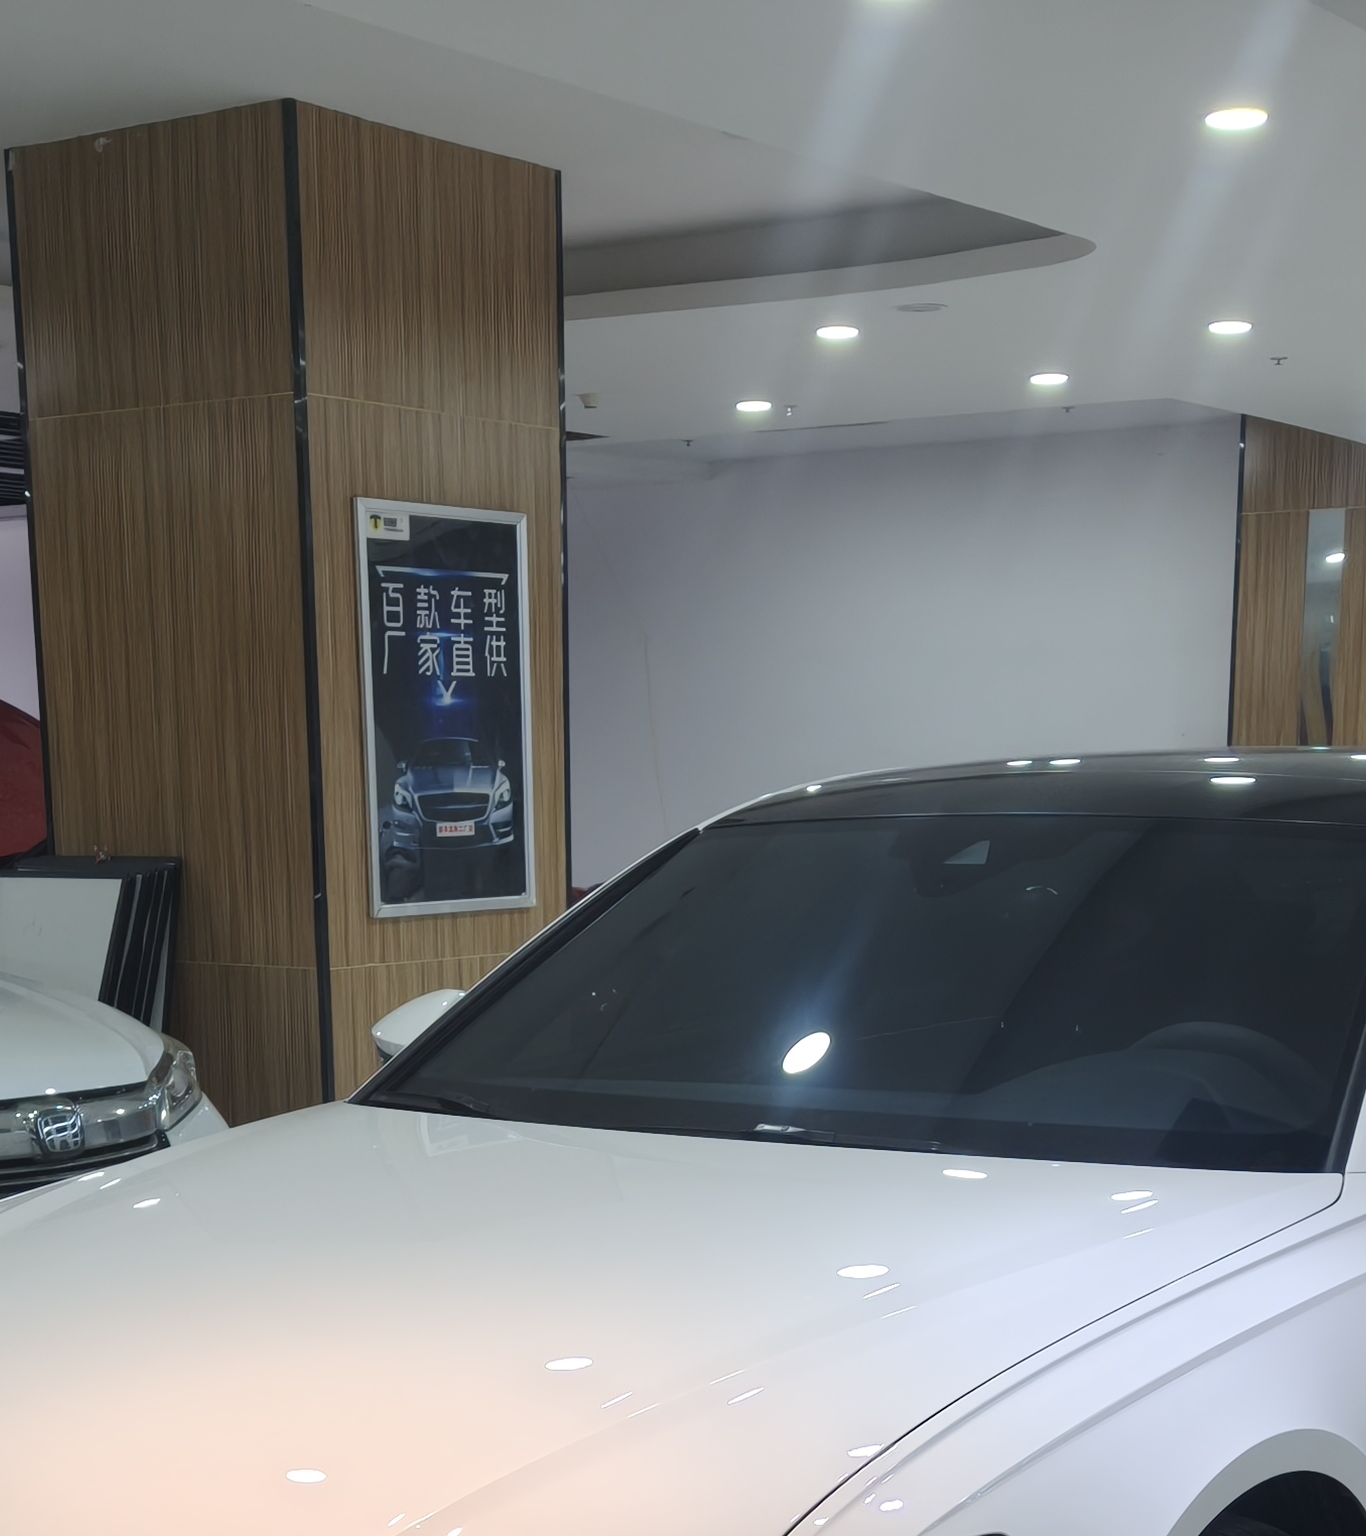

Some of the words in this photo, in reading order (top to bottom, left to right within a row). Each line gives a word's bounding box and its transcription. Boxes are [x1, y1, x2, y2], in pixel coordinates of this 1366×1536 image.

[381, 582, 506, 631] 百款车型
[383, 631, 508, 677] 厂家直供
